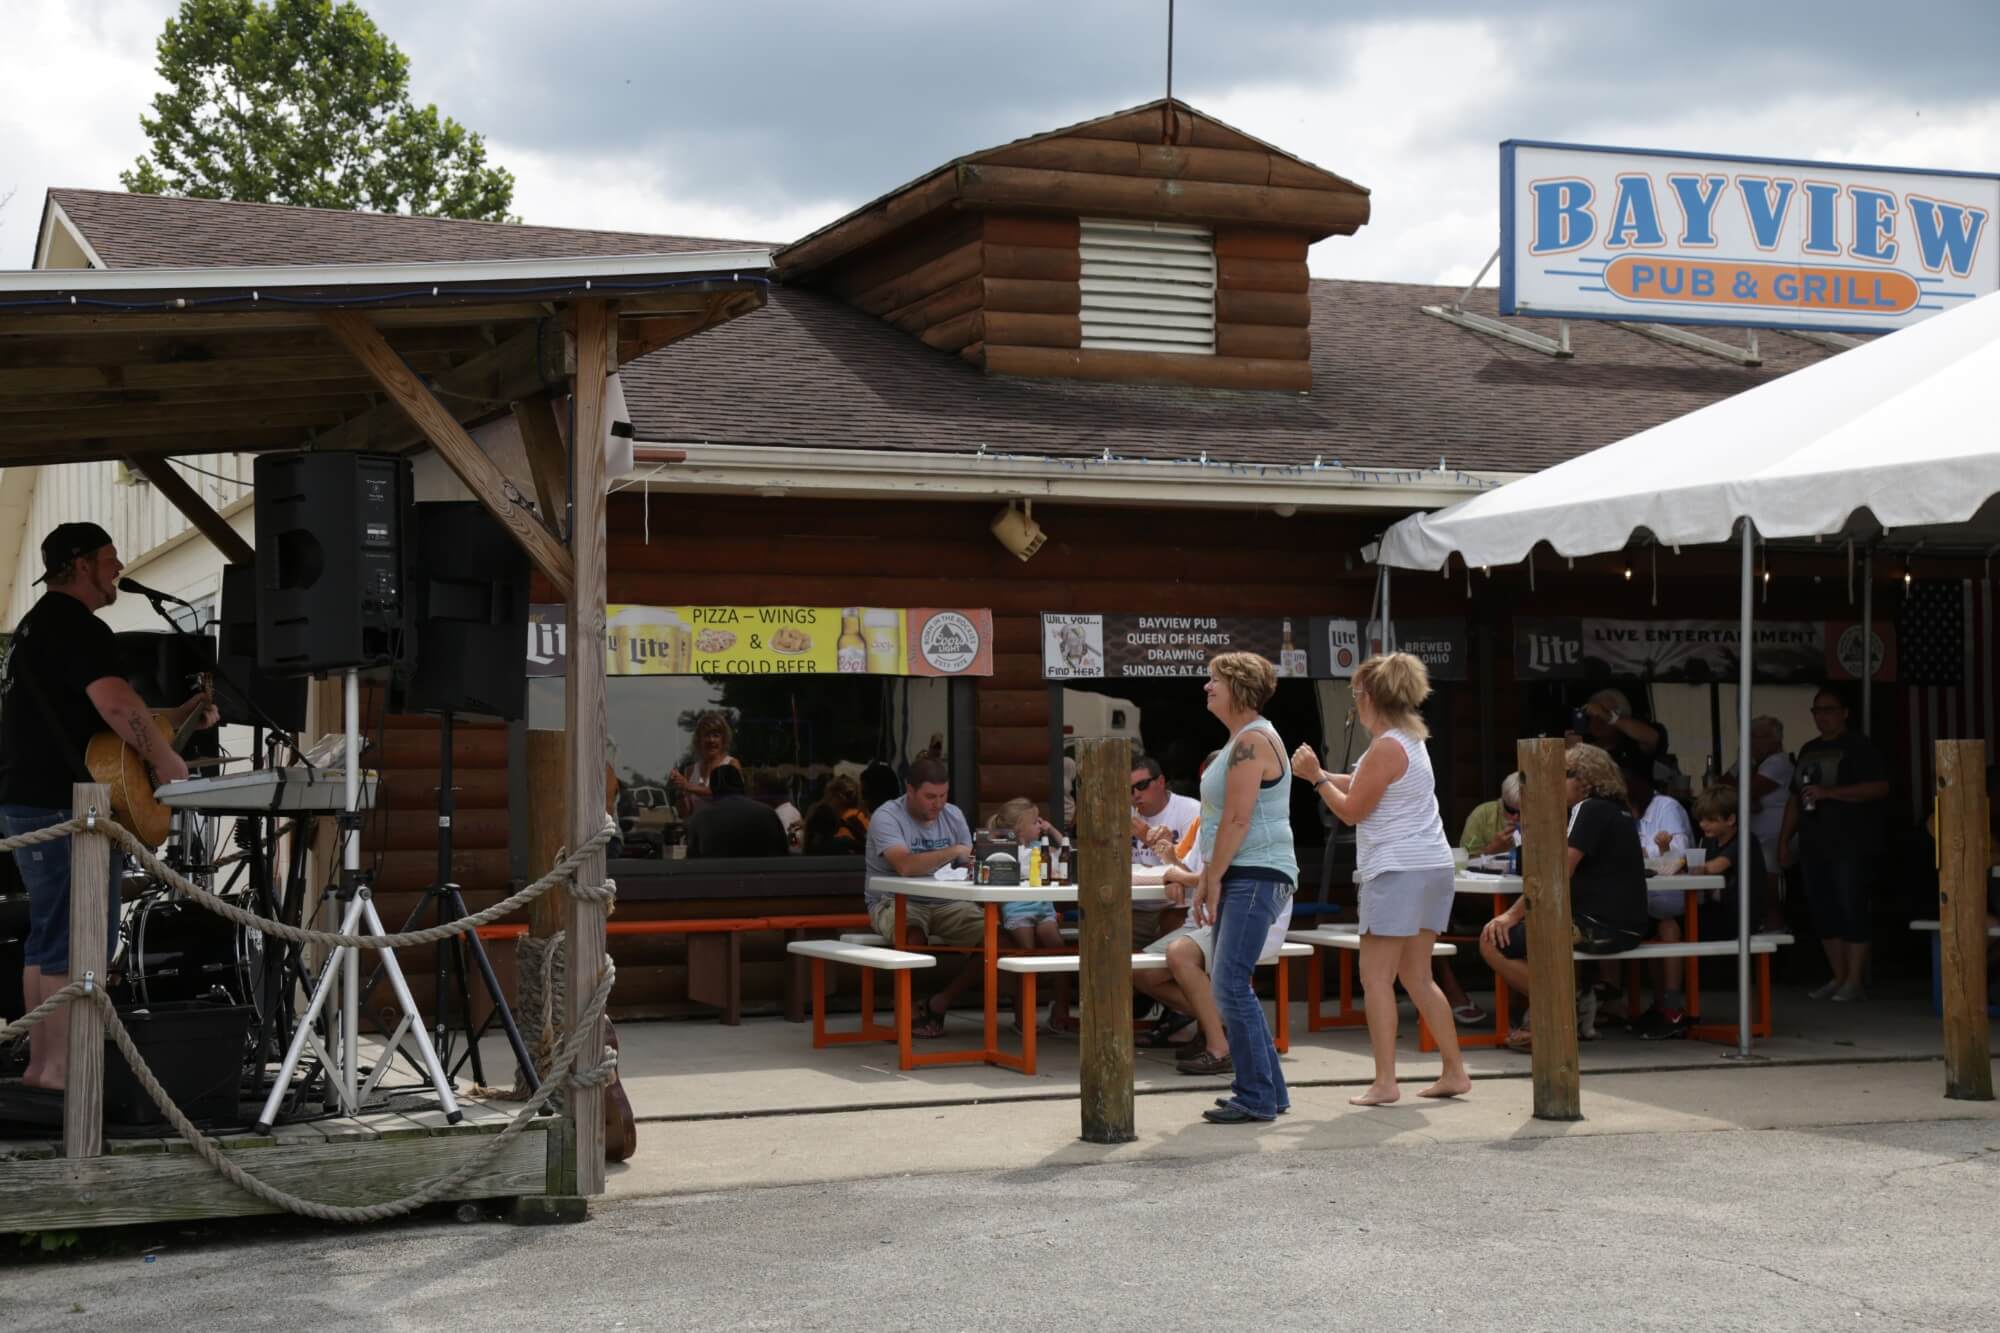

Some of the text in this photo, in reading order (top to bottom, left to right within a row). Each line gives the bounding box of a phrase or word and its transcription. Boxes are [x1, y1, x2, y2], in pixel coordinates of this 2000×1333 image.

[1529, 172, 1989, 279] BAYVIEW
[1631, 264, 1896, 308] PUB & GRILL
[693, 608, 739, 623] PIZZA
[759, 608, 816, 624] WINGS
[941, 614, 955, 622] THE
[1139, 617, 1217, 629] BAYVIEW PUB
[750, 634, 761, 649] &
[1127, 633, 1230, 645] QUEEN OF HEARTS
[1332, 631, 1356, 648] Lite
[1595, 629, 1638, 643] LIVE
[526, 622, 566, 665] Lit
[1405, 641, 1452, 653] BREWED
[630, 638, 670, 664] Lite
[1148, 649, 1205, 660] DRAWING
[1528, 633, 1581, 673] Lite
[1422, 653, 1450, 665] OHIO
[696, 660, 816, 674] ICE COLD BEER
[1122, 665, 1177, 676] SUNDAYS
[1179, 665, 1194, 676] AT
